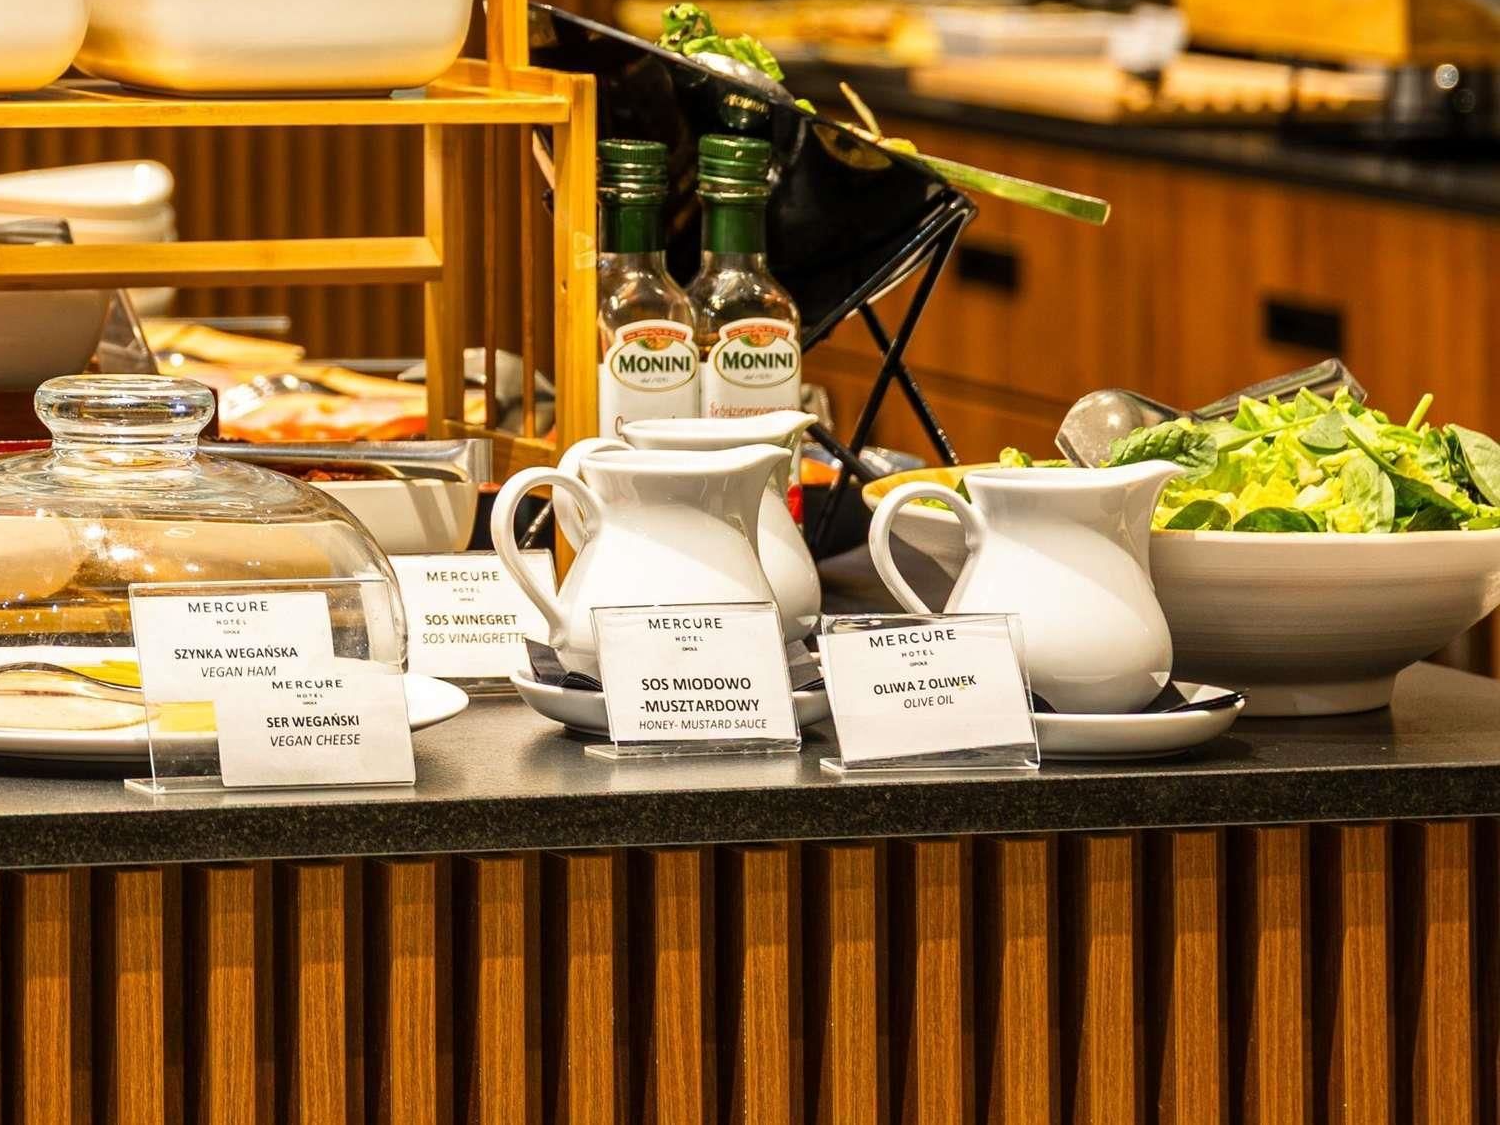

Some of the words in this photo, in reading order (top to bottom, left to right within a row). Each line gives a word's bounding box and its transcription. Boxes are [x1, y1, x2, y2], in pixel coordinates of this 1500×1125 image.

[619, 355, 690, 372] MONINI
[723, 352, 793, 369] MONINI
[426, 571, 501, 582] MERCURE
[188, 601, 269, 613] MERCURE
[425, 614, 449, 625] SOS
[452, 614, 517, 625] WINEGRET
[648, 618, 723, 629] MERCURE
[423, 633, 445, 644] SOS
[869, 629, 957, 648] MERCURE
[174, 648, 222, 660] SZYNKA
[226, 644, 299, 659] WEGAŃSKA
[901, 650, 934, 658] HOTEL
[201, 666, 242, 678] VEGAN
[247, 665, 277, 676] HAM
[272, 679, 343, 689] MERCURE
[641, 678, 669, 690] SOS
[673, 677, 751, 690] MIODOWO
[873, 681, 916, 695] OLIWA
[918, 680, 926, 691] Z
[928, 674, 977, 689] OLIWEK
[640, 699, 760, 713] -MUSZTARDOWY
[903, 696, 934, 709] OLIVE
[937, 695, 954, 706] OIL
[266, 716, 289, 728] SER
[292, 712, 360, 727] WEGAŃSKI
[681, 719, 732, 729] MUSTARD
[734, 718, 767, 728] SAUCE
[270, 735, 312, 747] VEGAN
[316, 733, 361, 746] CHEESE
